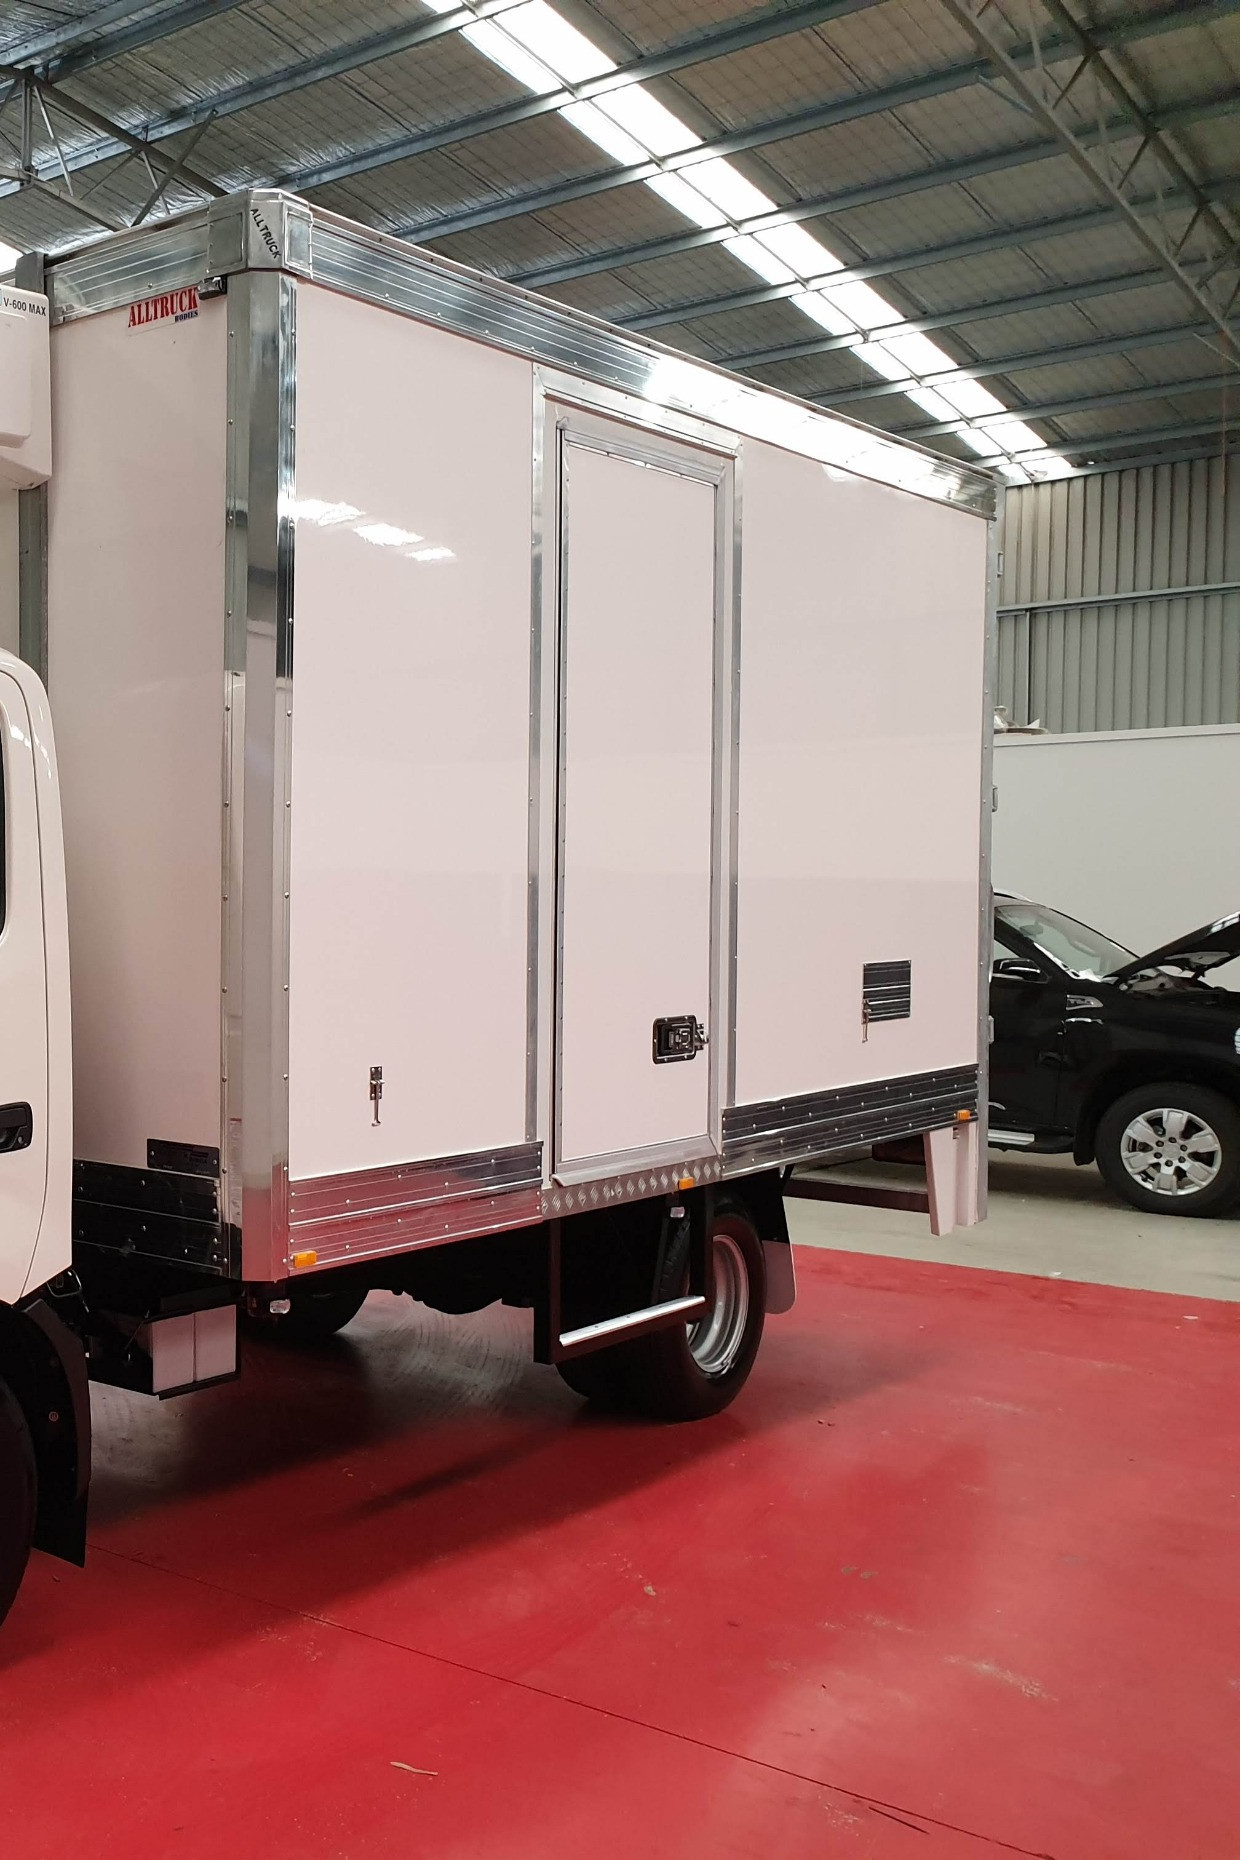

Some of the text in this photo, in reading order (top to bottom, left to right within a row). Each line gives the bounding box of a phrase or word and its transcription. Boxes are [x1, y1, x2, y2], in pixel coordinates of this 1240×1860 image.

[250, 208, 281, 259] ALLTRUCK
[3, 297, 27, 311] V-600
[28, 303, 47, 316] MAX
[128, 286, 198, 327] ALLTRUCK
[174, 310, 198, 323] BODIES
